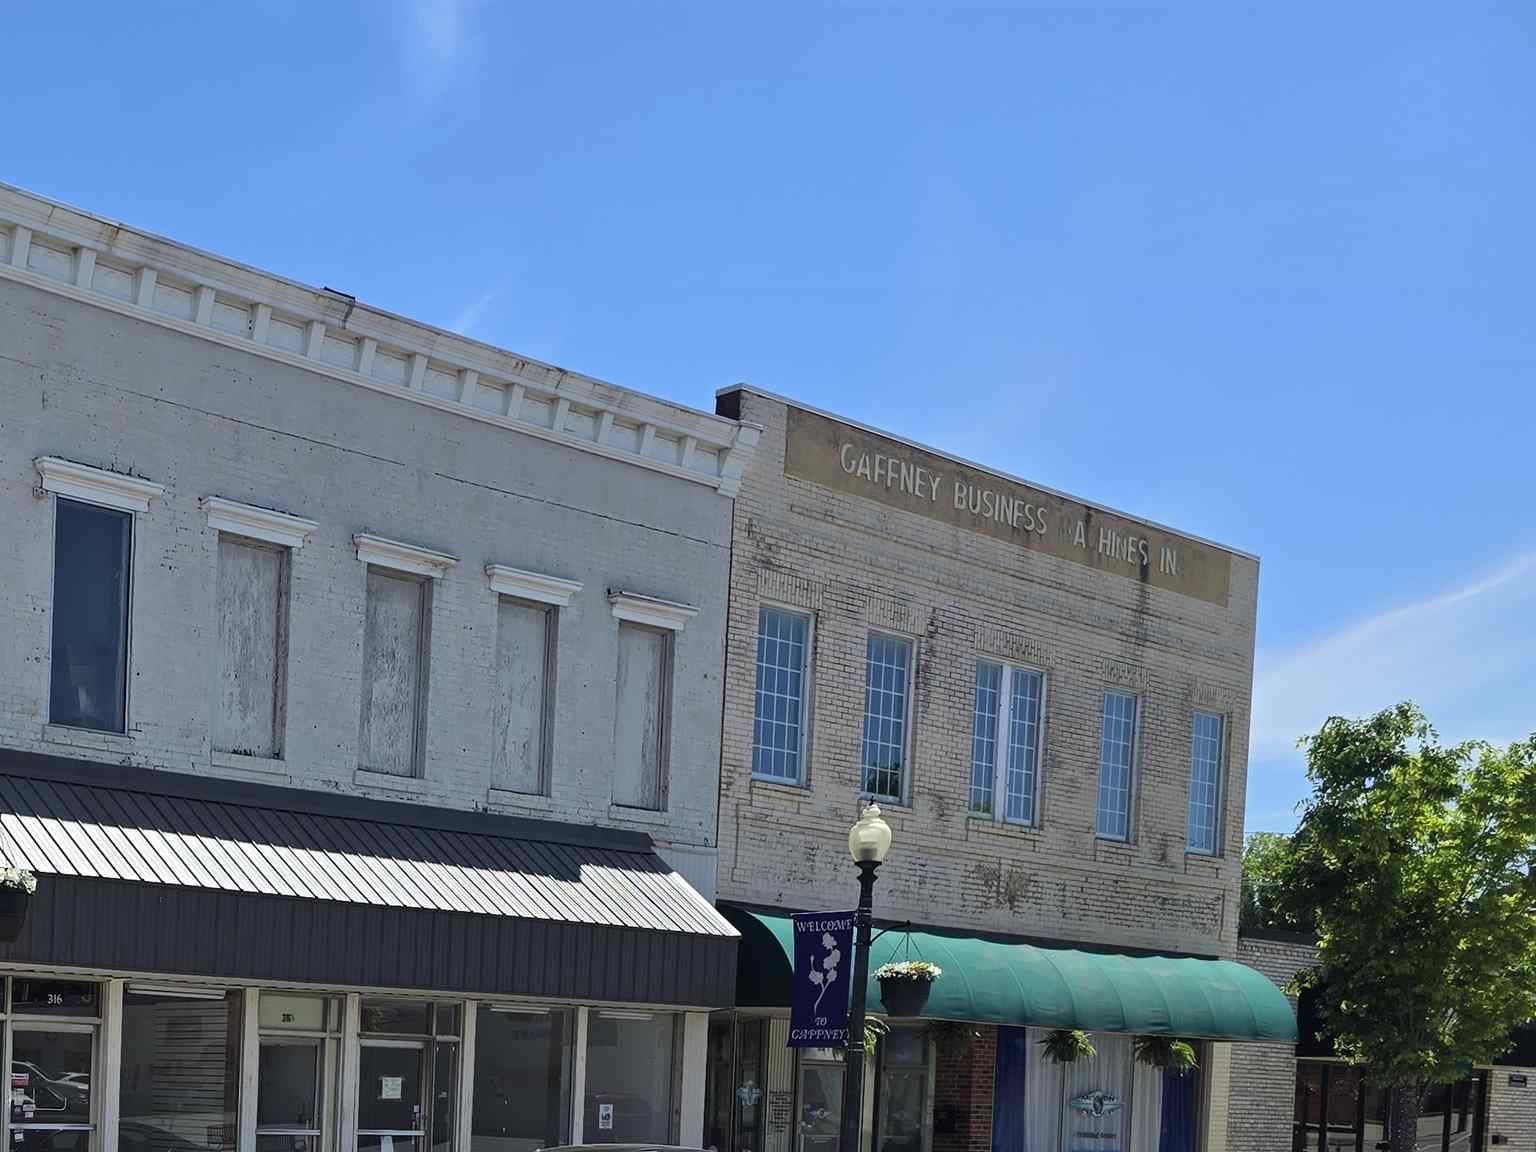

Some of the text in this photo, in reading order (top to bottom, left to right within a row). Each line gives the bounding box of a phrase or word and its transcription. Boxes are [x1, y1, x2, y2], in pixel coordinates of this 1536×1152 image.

[840, 443, 941, 501] GAFFNEY
[953, 479, 1049, 535] BUSINESS
[1098, 527, 1150, 567] HINES
[796, 918, 853, 933] WELCOME
[47, 993, 63, 1005] 316
[814, 1016, 827, 1026] TO
